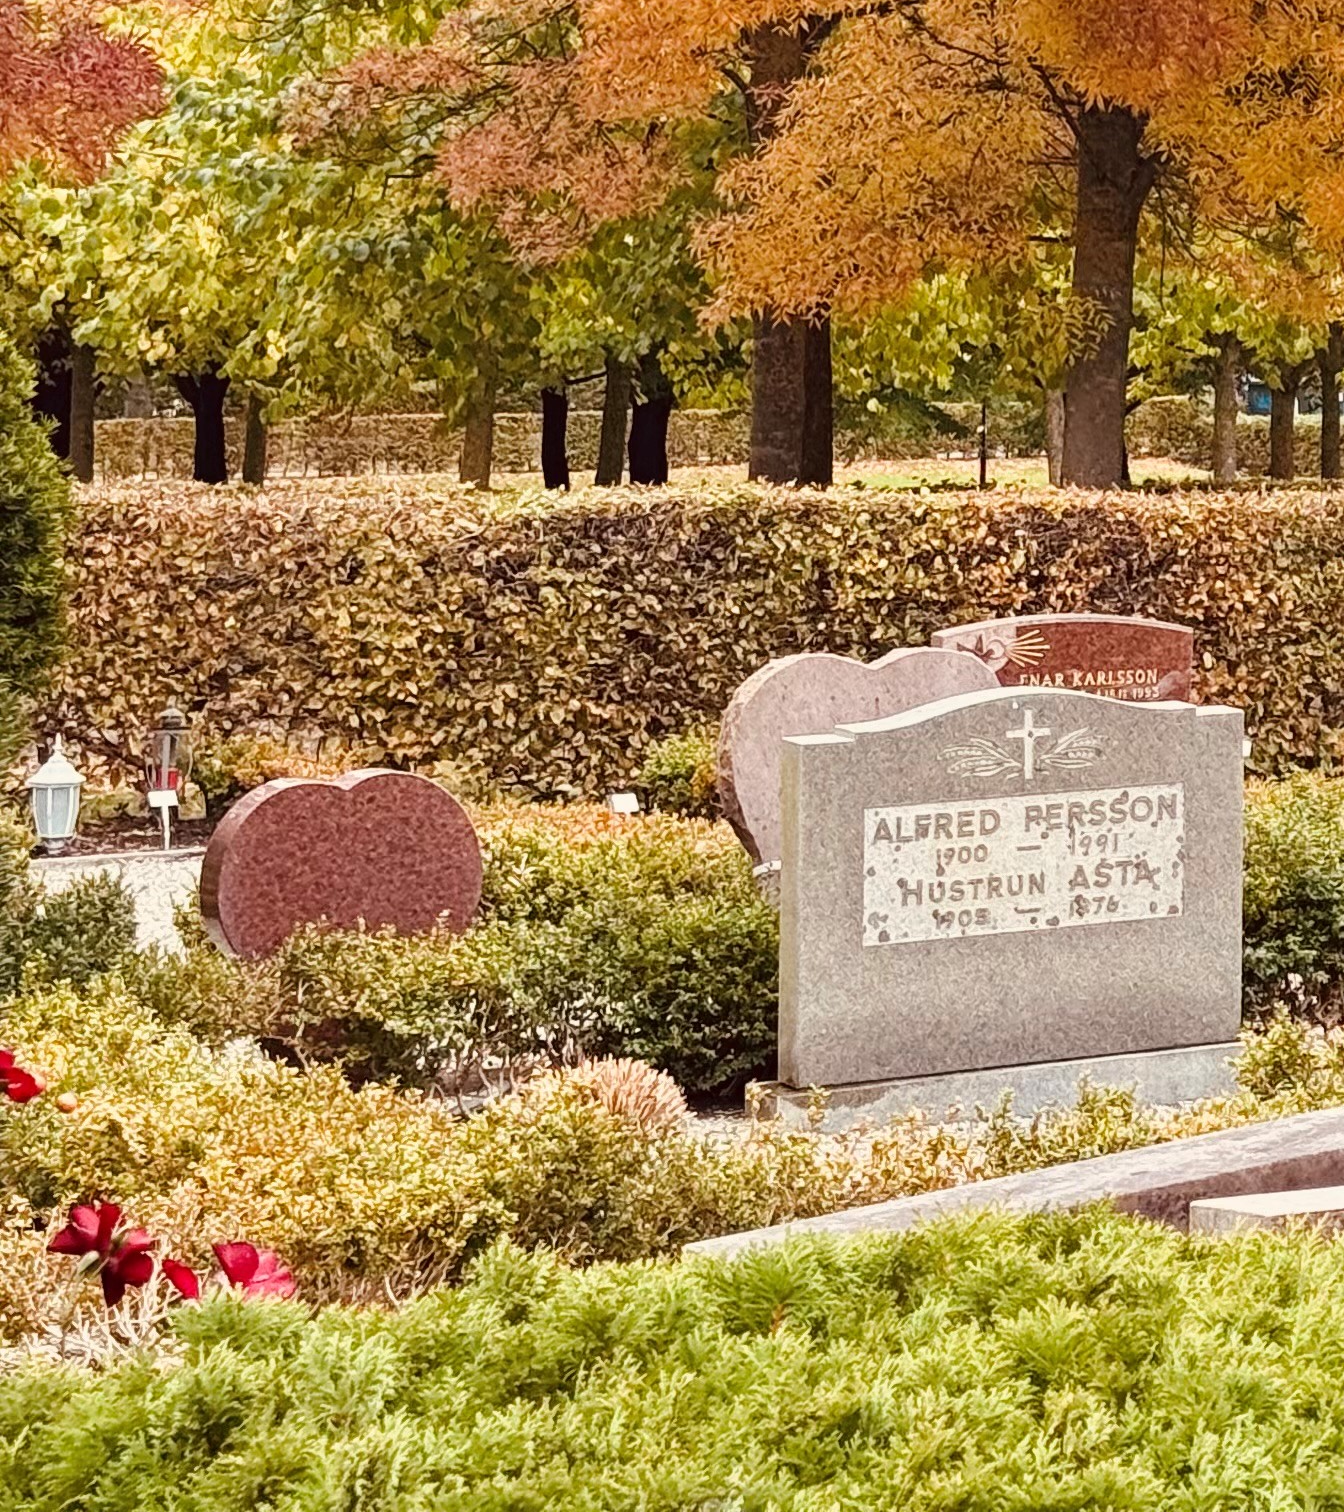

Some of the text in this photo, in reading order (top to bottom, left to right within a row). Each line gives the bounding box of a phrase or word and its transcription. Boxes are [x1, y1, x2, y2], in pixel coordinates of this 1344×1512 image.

[1072, 668, 1159, 687] KARLSSON
[872, 792, 1178, 845] ALFRED PERSSON
[936, 843, 989, 867] 1900
[1068, 832, 1121, 856] 1991
[897, 858, 1160, 908] HUSTRUN ASTA
